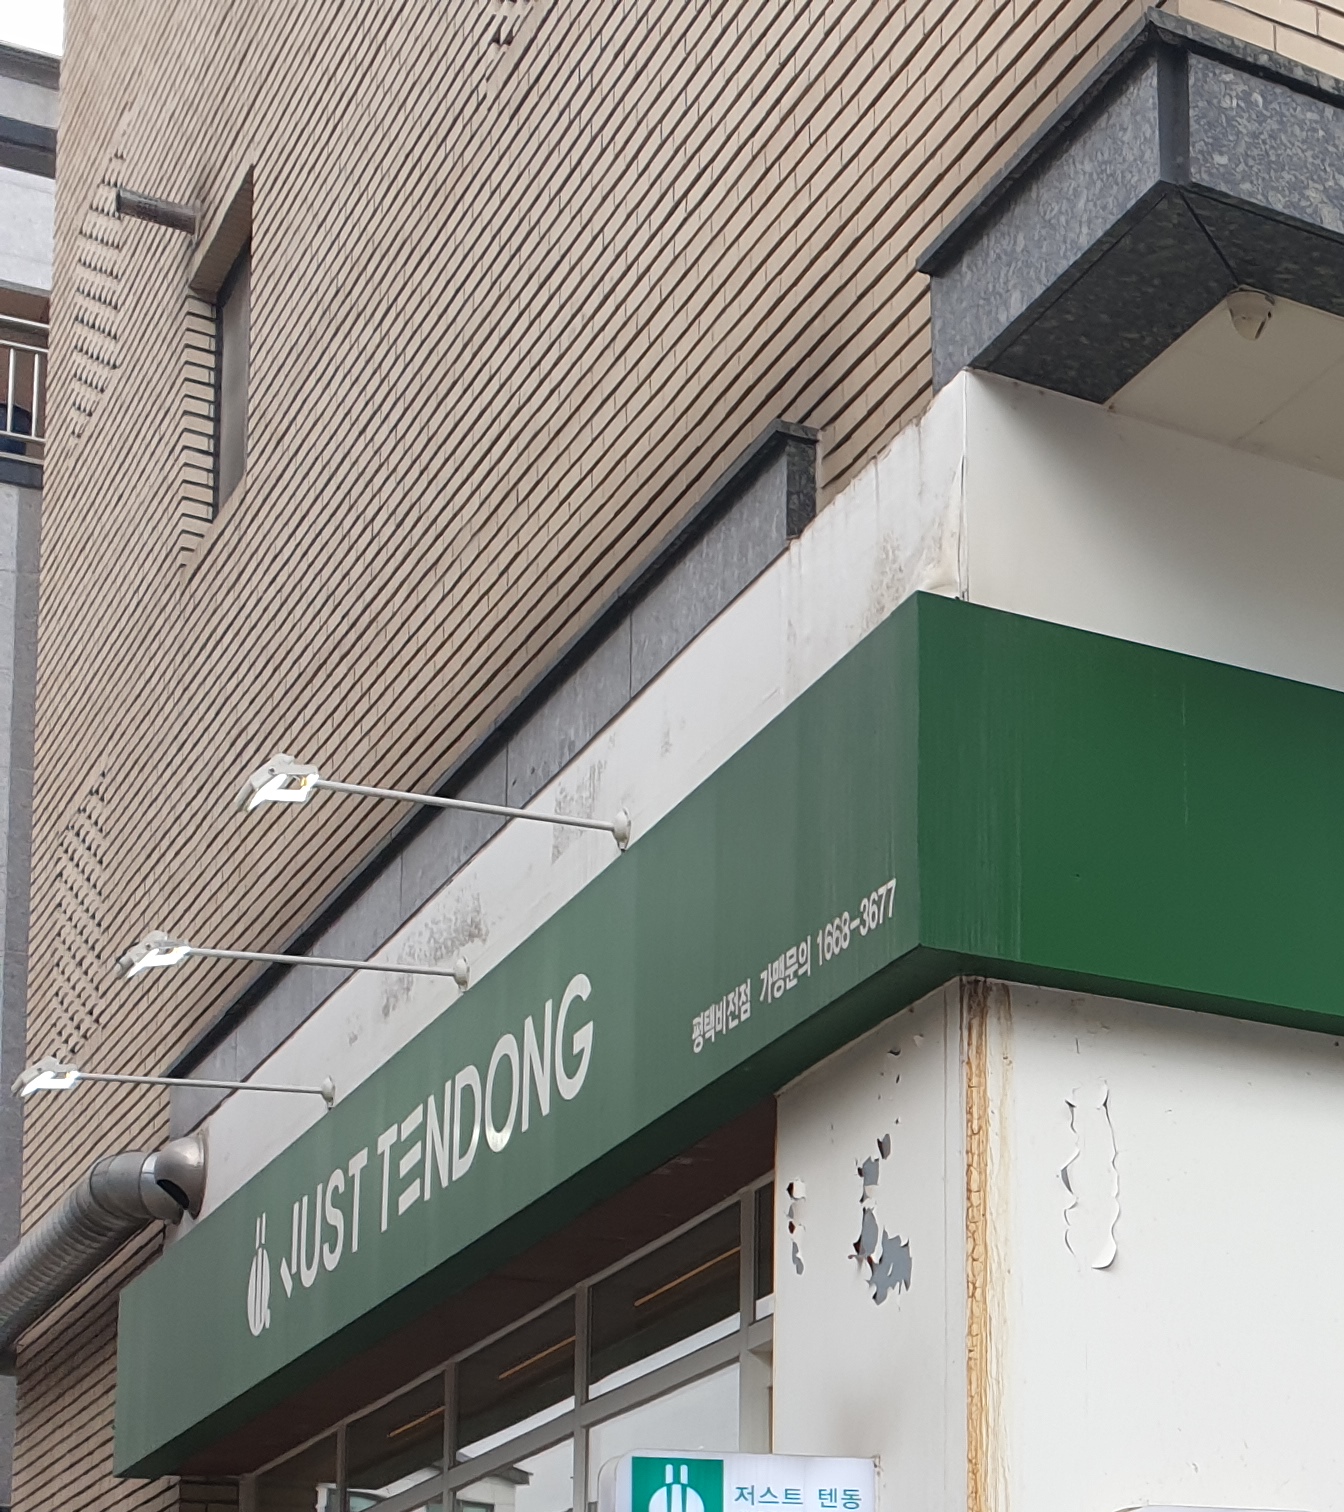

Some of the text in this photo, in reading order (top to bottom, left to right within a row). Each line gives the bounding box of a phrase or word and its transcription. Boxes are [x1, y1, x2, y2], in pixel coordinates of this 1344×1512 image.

[692, 878, 896, 1053] 평택비전점 가맹문의 1668-3677
[279, 973, 593, 1299] JUST TENDONG
[734, 1485, 862, 1510] 저스트 텐동
